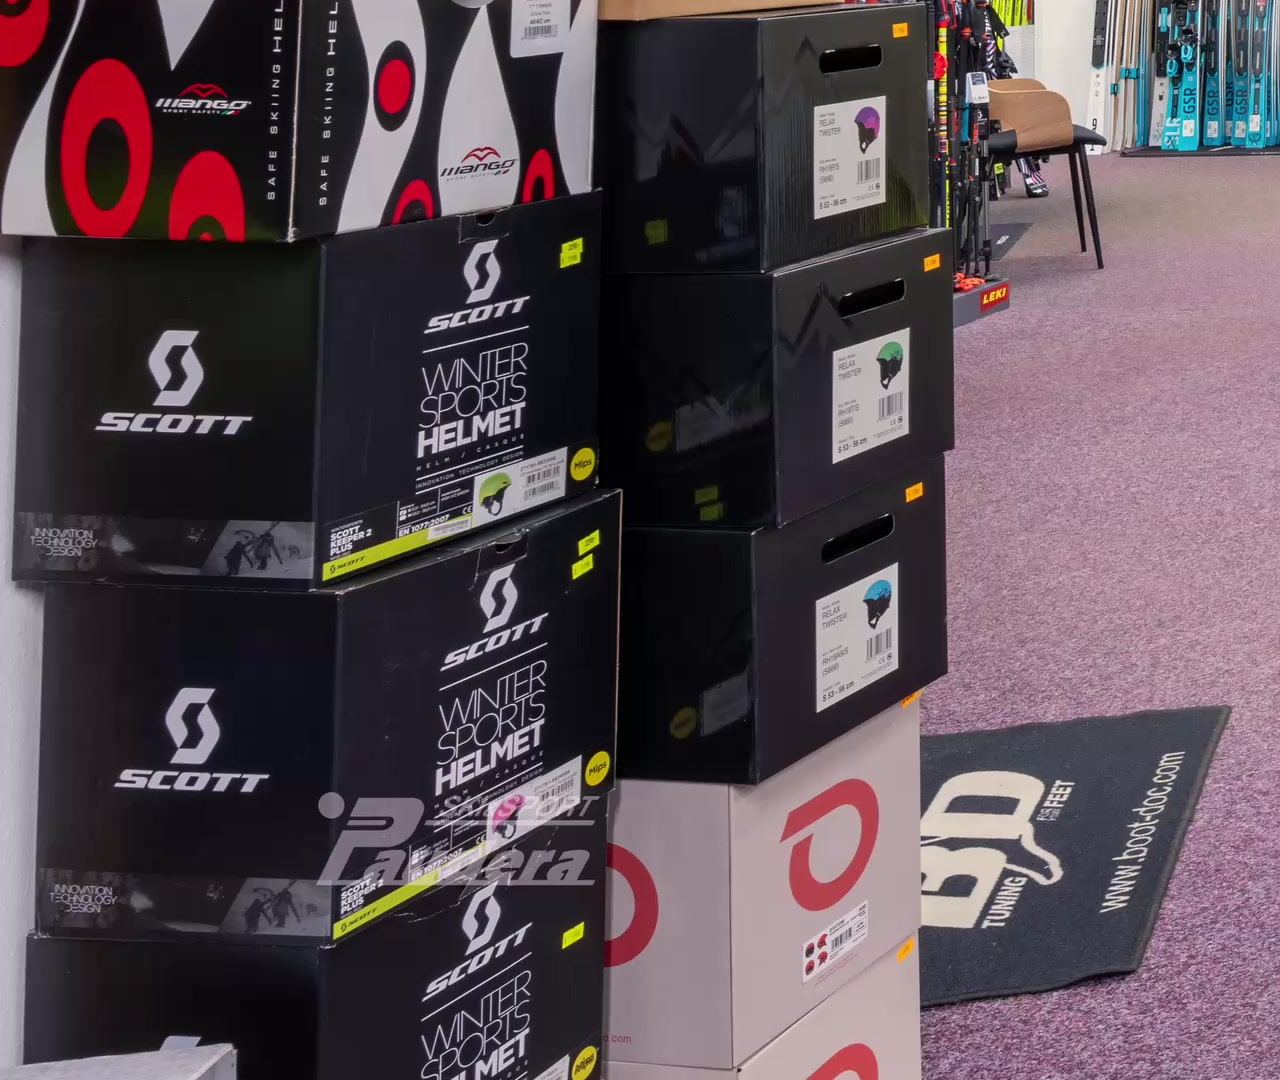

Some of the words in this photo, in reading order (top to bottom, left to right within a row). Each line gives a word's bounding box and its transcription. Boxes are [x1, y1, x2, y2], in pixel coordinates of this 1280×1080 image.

[269, 64, 281, 135] SKIING
[322, 68, 336, 139] SKIING
[1183, 87, 1197, 114] GSR
[1208, 89, 1219, 115] GSR
[1236, 88, 1249, 115] GSR
[819, 118, 836, 127] RELAX
[819, 127, 841, 137] TWISTER
[266, 150, 278, 201] SAFE
[440, 157, 519, 178] mango
[318, 155, 330, 206] SAFE
[983, 287, 1007, 304] LEKI
[424, 296, 530, 334] SCOTT
[422, 342, 528, 396] WINTER
[838, 360, 856, 371] RELAX
[838, 368, 862, 380] TWISTER
[420, 373, 527, 429] SPORTS
[95, 412, 253, 434] SCOTT
[417, 403, 527, 458] HELMET
[416, 457, 450, 472] HELM
[477, 434, 525, 453] CASQUE
[574, 457, 592, 472] Mips
[415, 473, 455, 489] INNOVATION
[459, 459, 499, 476] TECHNOLOGY
[502, 451, 524, 463] DESIGN
[34, 528, 94, 540] INNOVATION
[331, 525, 360, 541] SCOTT
[399, 528, 409, 537] EN
[411, 514, 450, 532] 1077:2007
[29, 537, 99, 550] TECHNOLOGY
[330, 531, 365, 548] KEEPER
[366, 528, 372, 537] 2
[330, 542, 353, 556] PLUS
[45, 545, 82, 557] DESIGN
[337, 556, 365, 569] SCOTT
[822, 605, 841, 619] RELAX
[822, 613, 848, 629] TWISTER
[440, 612, 549, 672] SCOTT
[438, 659, 547, 731] WINTER
[437, 690, 546, 765] SPORTS
[435, 719, 544, 797] HELMET
[588, 761, 607, 777] Mips
[114, 769, 270, 792] SCOTT
[1050, 780, 1075, 807] FEET
[410, 869, 422, 882] EN
[423, 848, 463, 874] 1077:2007
[48, 892, 119, 906] TECHNOLOGY
[53, 884, 113, 898] INNOVATION
[341, 879, 371, 900] SCOTT
[341, 884, 376, 908] KEEPER
[377, 878, 384, 888] 2
[65, 902, 101, 913] DESIGN
[340, 897, 364, 915] PLUS
[981, 877, 1028, 928] TUNING
[421, 922, 533, 1003] SCOTT
[421, 970, 532, 1060] WINTER
[421, 999, 530, 1080] SPORTS
[574, 1053, 595, 1077] Mips
